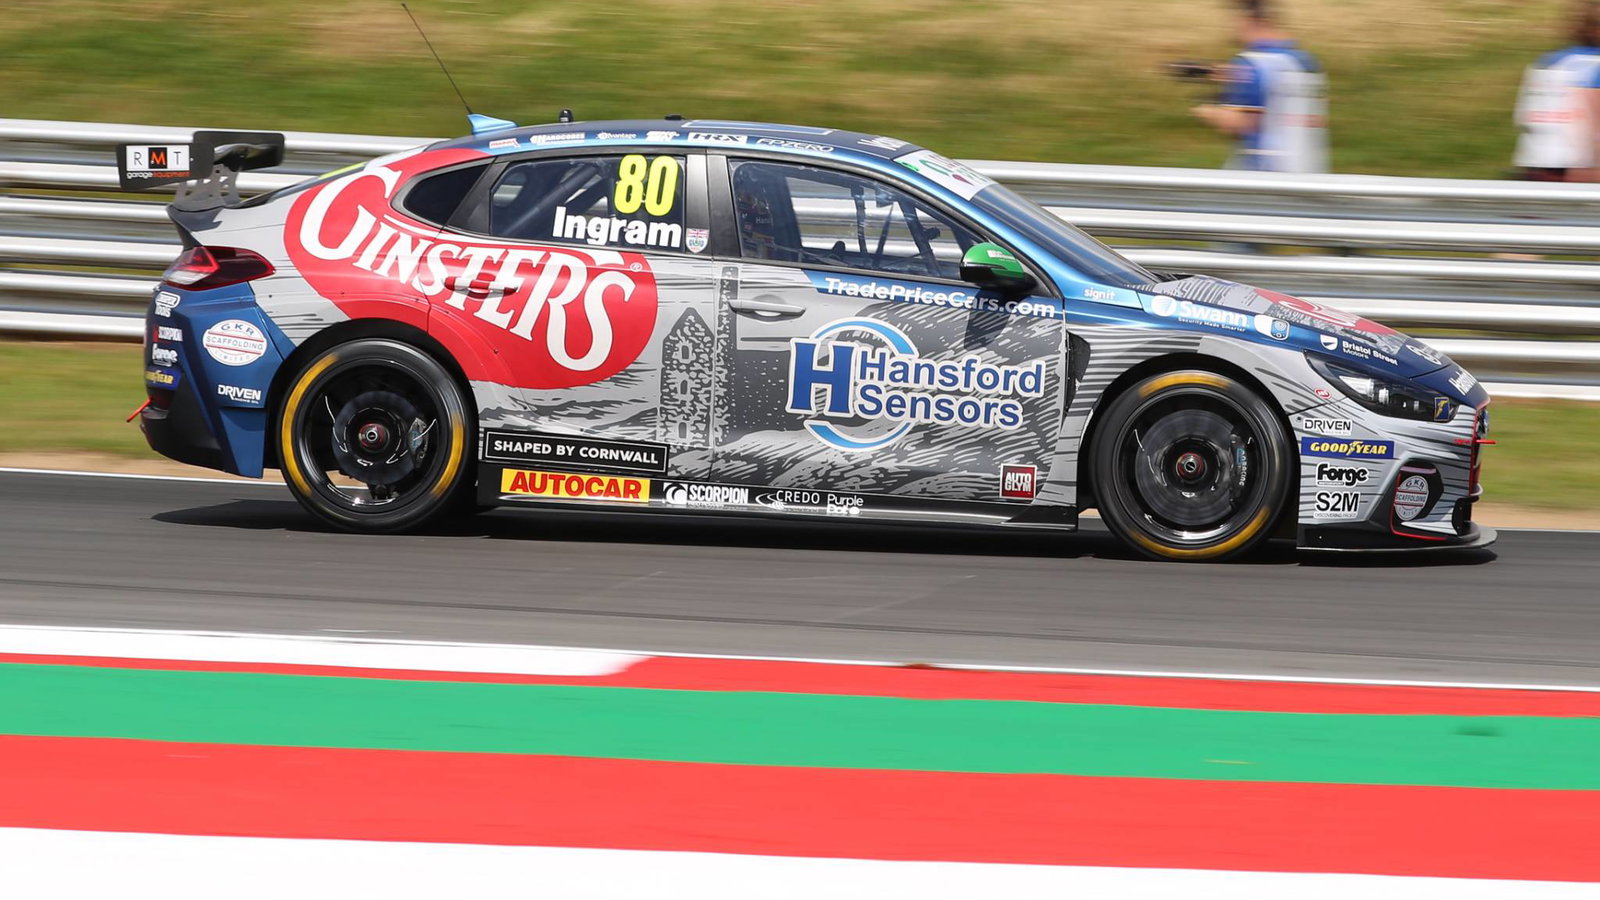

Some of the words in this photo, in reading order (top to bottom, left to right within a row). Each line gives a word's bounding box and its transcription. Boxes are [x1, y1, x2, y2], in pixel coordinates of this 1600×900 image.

[614, 154, 678, 216] 80
[552, 206, 682, 249] Ingram
[299, 165, 636, 371] GINSTERS
[824, 277, 1056, 318] TradePriceCars.com
[1180, 301, 1248, 328] Swann
[221, 323, 255, 336] GKR
[205, 335, 264, 351] SCAFFOLDING
[1342, 340, 1371, 355] Bristol
[1372, 350, 1398, 366] Street
[1342, 348, 1370, 360] Motors
[860, 351, 1042, 394] Hansford
[217, 385, 262, 400] DRIVEN
[858, 385, 1020, 427] Sensors
[1305, 420, 1351, 433] DRIVEN
[494, 440, 552, 454] SHAPED
[556, 445, 575, 456] BY
[579, 447, 659, 464] CORNWALL
[509, 471, 642, 500] AUTOCAR
[1004, 481, 1032, 492] GLYM
[1005, 472, 1032, 482] AUTO
[689, 484, 749, 504] SCORPION
[776, 490, 820, 504] CREDO
[827, 493, 864, 507] Purple
[1316, 492, 1359, 512] S2M
